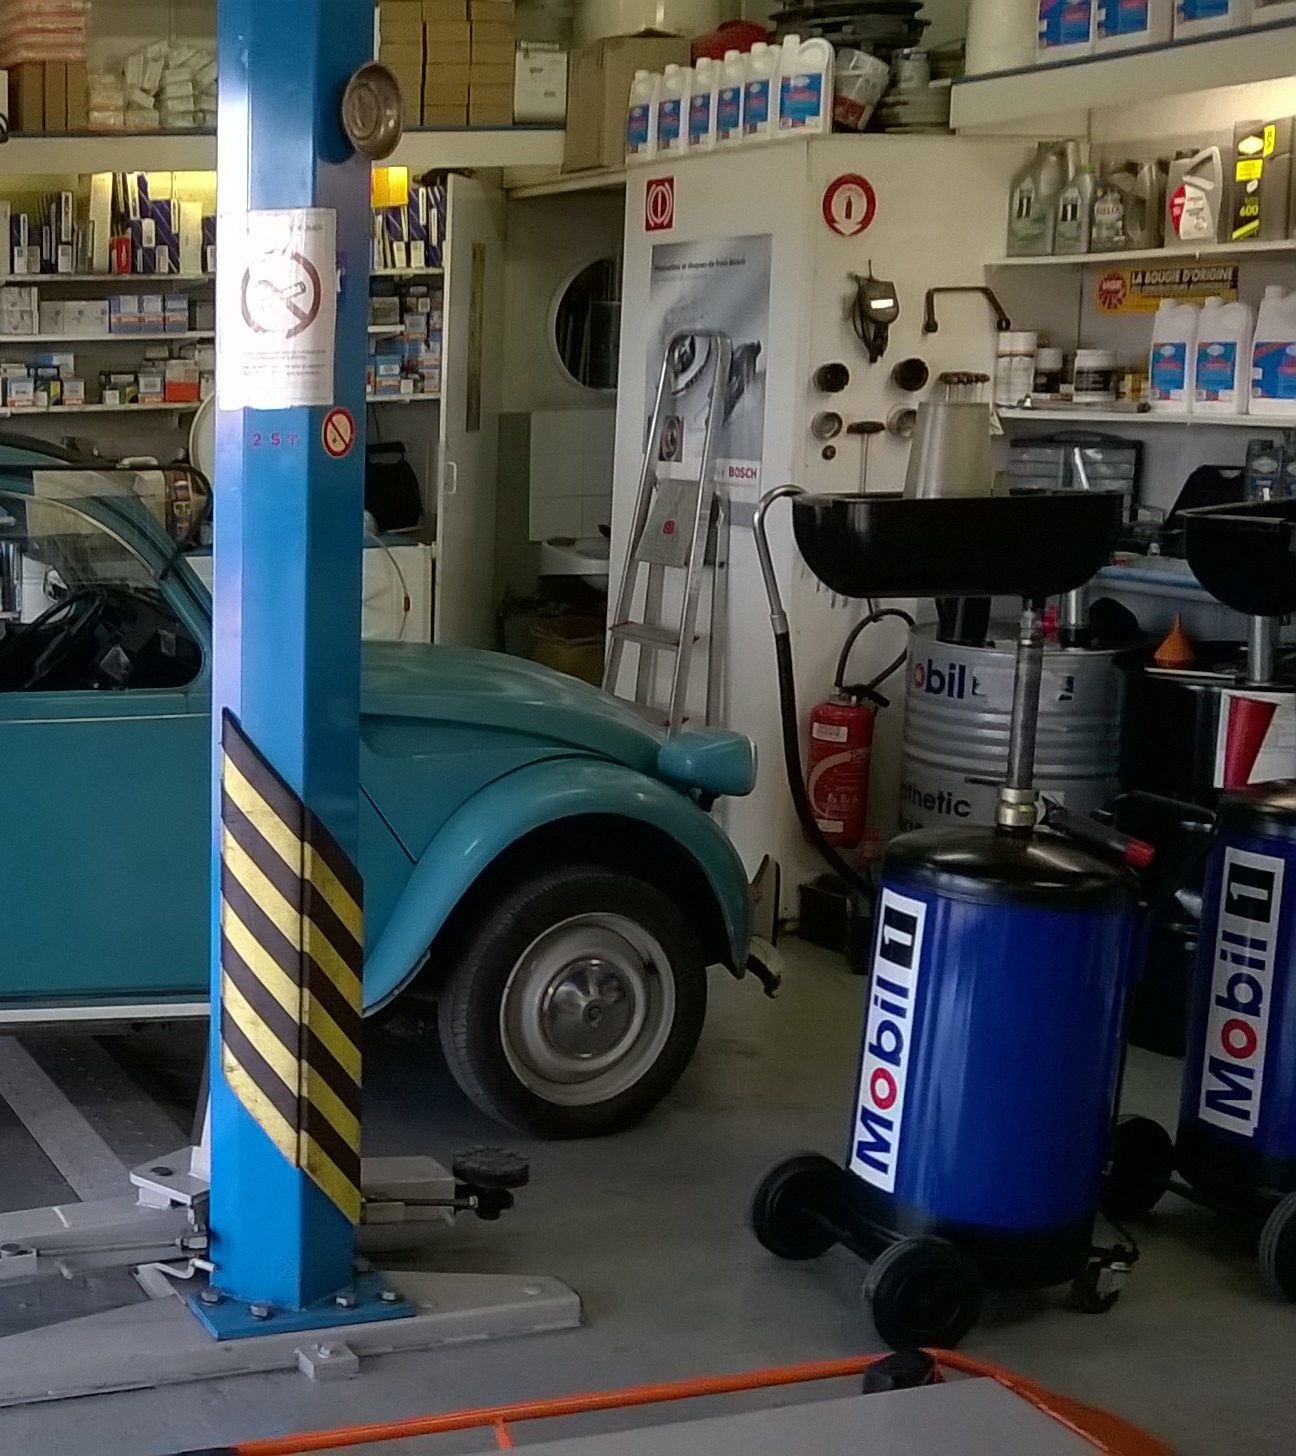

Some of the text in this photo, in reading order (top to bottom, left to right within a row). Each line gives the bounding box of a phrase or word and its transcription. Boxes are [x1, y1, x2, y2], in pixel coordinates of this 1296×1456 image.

[1131, 270, 1143, 285] LA
[1144, 268, 1181, 284] BOUGIE
[728, 465, 758, 479] BOSCH
[855, 974, 911, 1176] Mobil
[1204, 929, 1269, 1122] Mobil
